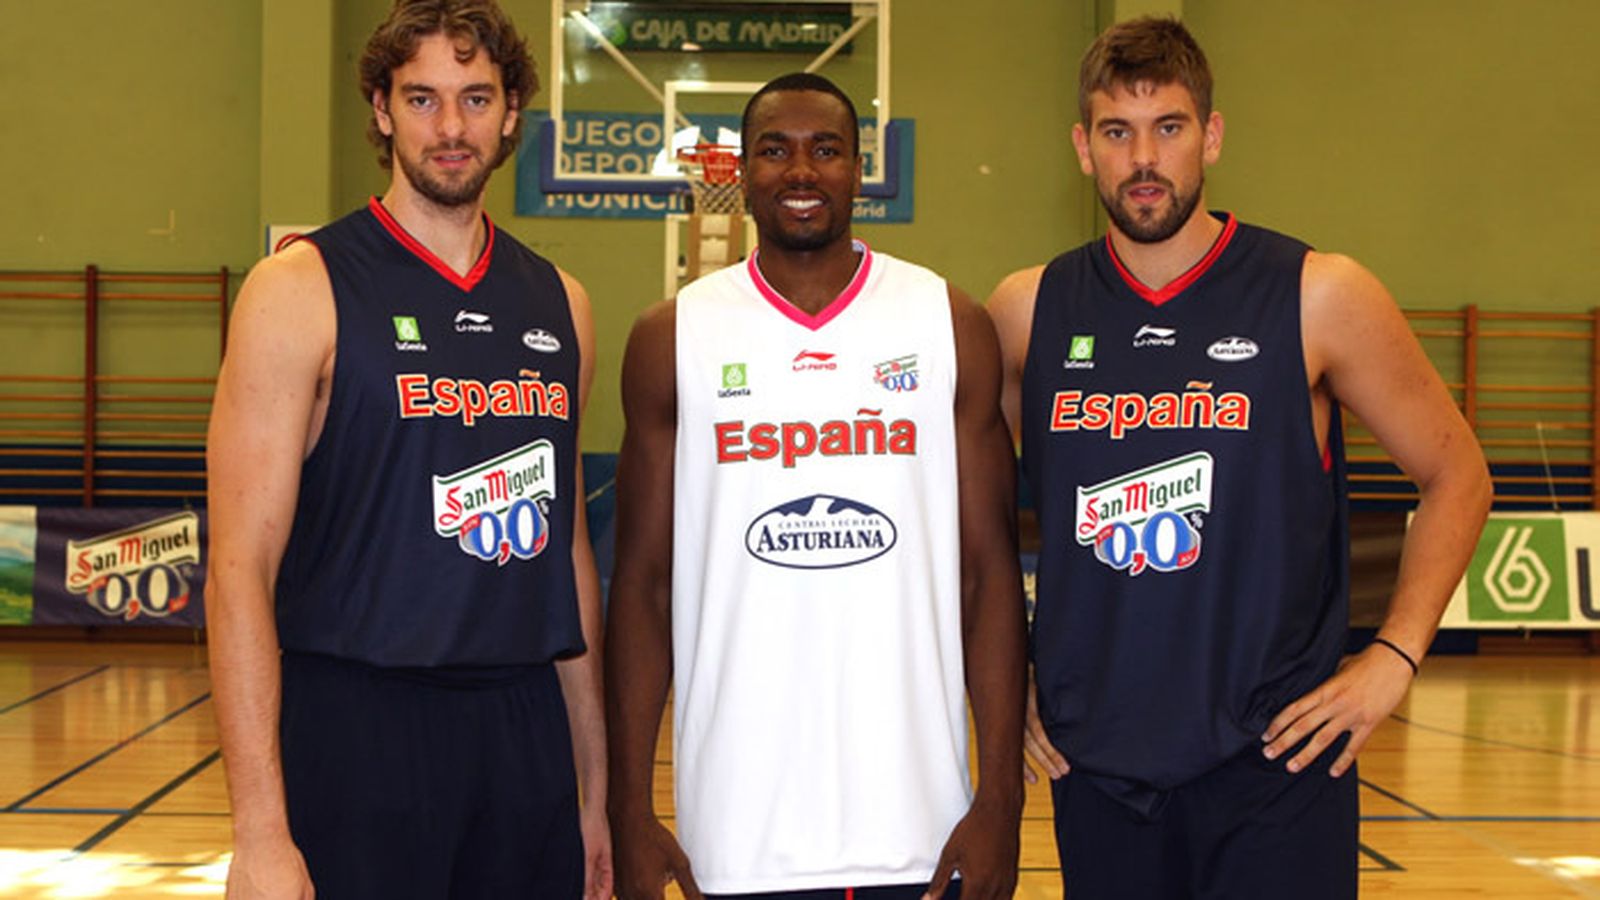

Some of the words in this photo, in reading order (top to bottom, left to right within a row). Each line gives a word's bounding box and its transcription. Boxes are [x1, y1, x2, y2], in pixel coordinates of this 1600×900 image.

[631, 20, 688, 48] CAJA
[696, 21, 730, 41] DE
[738, 20, 844, 48] MADRID
[562, 120, 662, 147] UEGO
[546, 193, 685, 210] MUNICI
[852, 203, 886, 217] drid
[396, 369, 569, 426] España
[1051, 381, 1250, 439] España
[714, 408, 917, 468] España
[439, 486, 487, 526] San
[484, 456, 545, 501] Miguel
[1079, 497, 1123, 534] San
[1122, 468, 1202, 513] Miguel
[70, 550, 117, 583] San
[118, 526, 190, 564] Miguel
[757, 525, 885, 552] ASTURIANA
